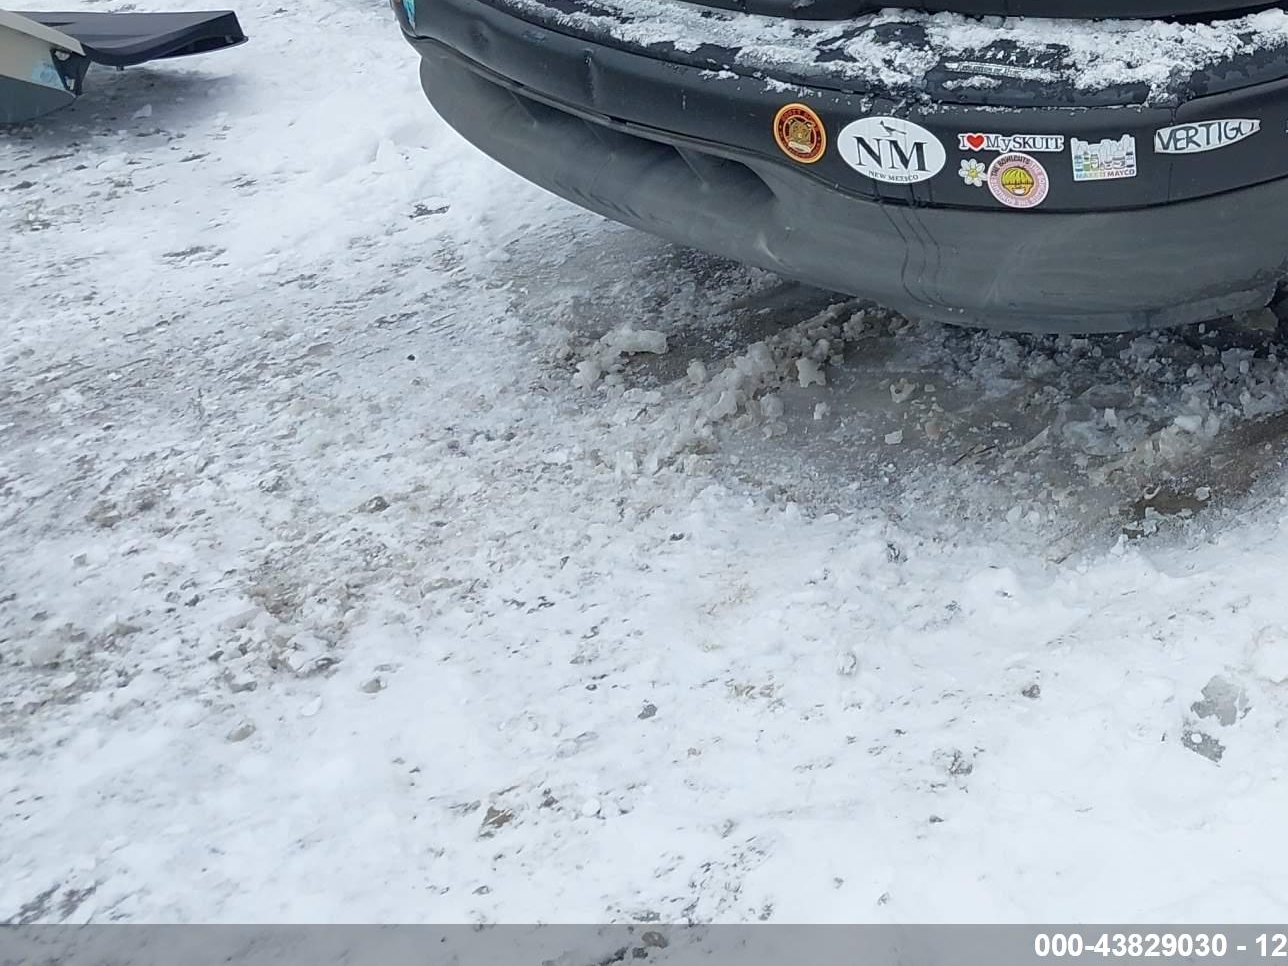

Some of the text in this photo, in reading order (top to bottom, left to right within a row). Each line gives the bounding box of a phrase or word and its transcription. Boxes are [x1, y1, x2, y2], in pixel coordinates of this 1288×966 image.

[852, 135, 932, 173] NM
[869, 170, 919, 182] NEW MEXICO
[1107, 169, 1135, 178] MAYCO
